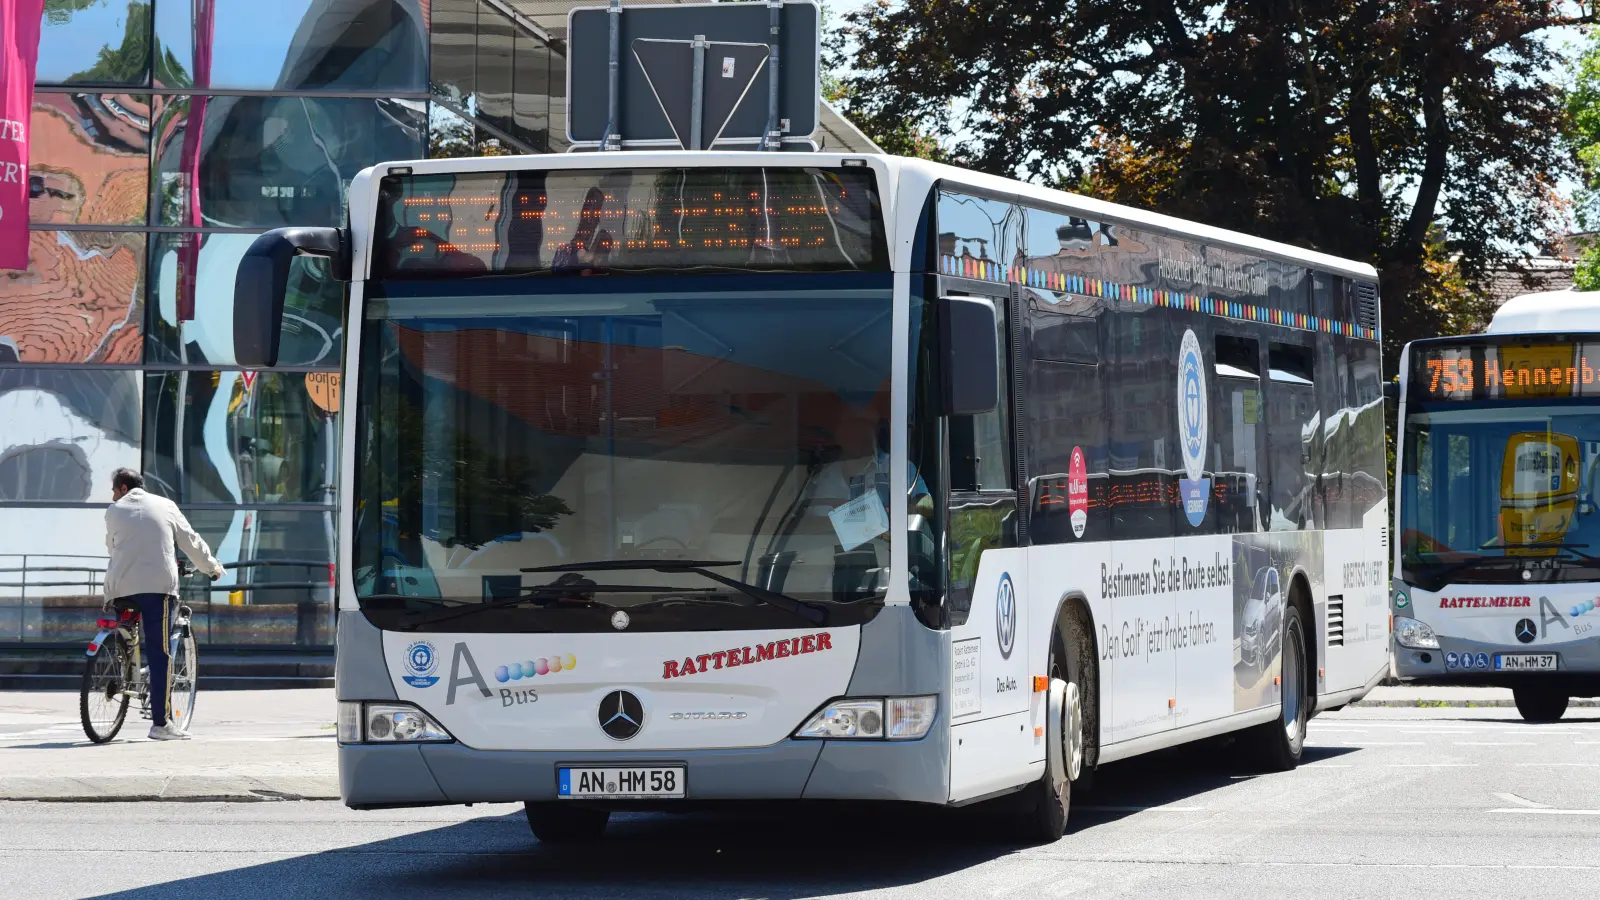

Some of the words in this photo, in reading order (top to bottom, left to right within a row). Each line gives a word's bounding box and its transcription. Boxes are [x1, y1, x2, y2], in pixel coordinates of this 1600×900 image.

[1211, 261, 1224, 288] und
[1426, 359, 1474, 393] 753
[1484, 357, 1600, 388] Hennenb
[1101, 562, 1151, 599] Bestimmen
[1152, 557, 1166, 595] Sie
[1167, 555, 1181, 592] die
[1182, 556, 1206, 591] Route
[1206, 551, 1232, 588] selbst.
[1438, 595, 1532, 609] RATTELMEIER
[1538, 595, 1570, 639] A
[1573, 621, 1593, 636] Bus
[1101, 623, 1120, 661] Den
[1145, 619, 1163, 664] jetzt
[1164, 611, 1188, 651] Probe
[1189, 609, 1217, 647] fahren.
[662, 631, 833, 680] RATTELMEIER
[1505, 655, 1519, 668] AN
[1525, 655, 1539, 668] HM
[1541, 655, 1553, 668] 37
[445, 641, 494, 706] A
[996, 677, 1006, 693] Das
[1006, 675, 1018, 691] Auto.
[499, 687, 539, 708] Bus
[578, 771, 605, 792] AN
[619, 770, 646, 792] HM
[650, 770, 676, 792] 58
